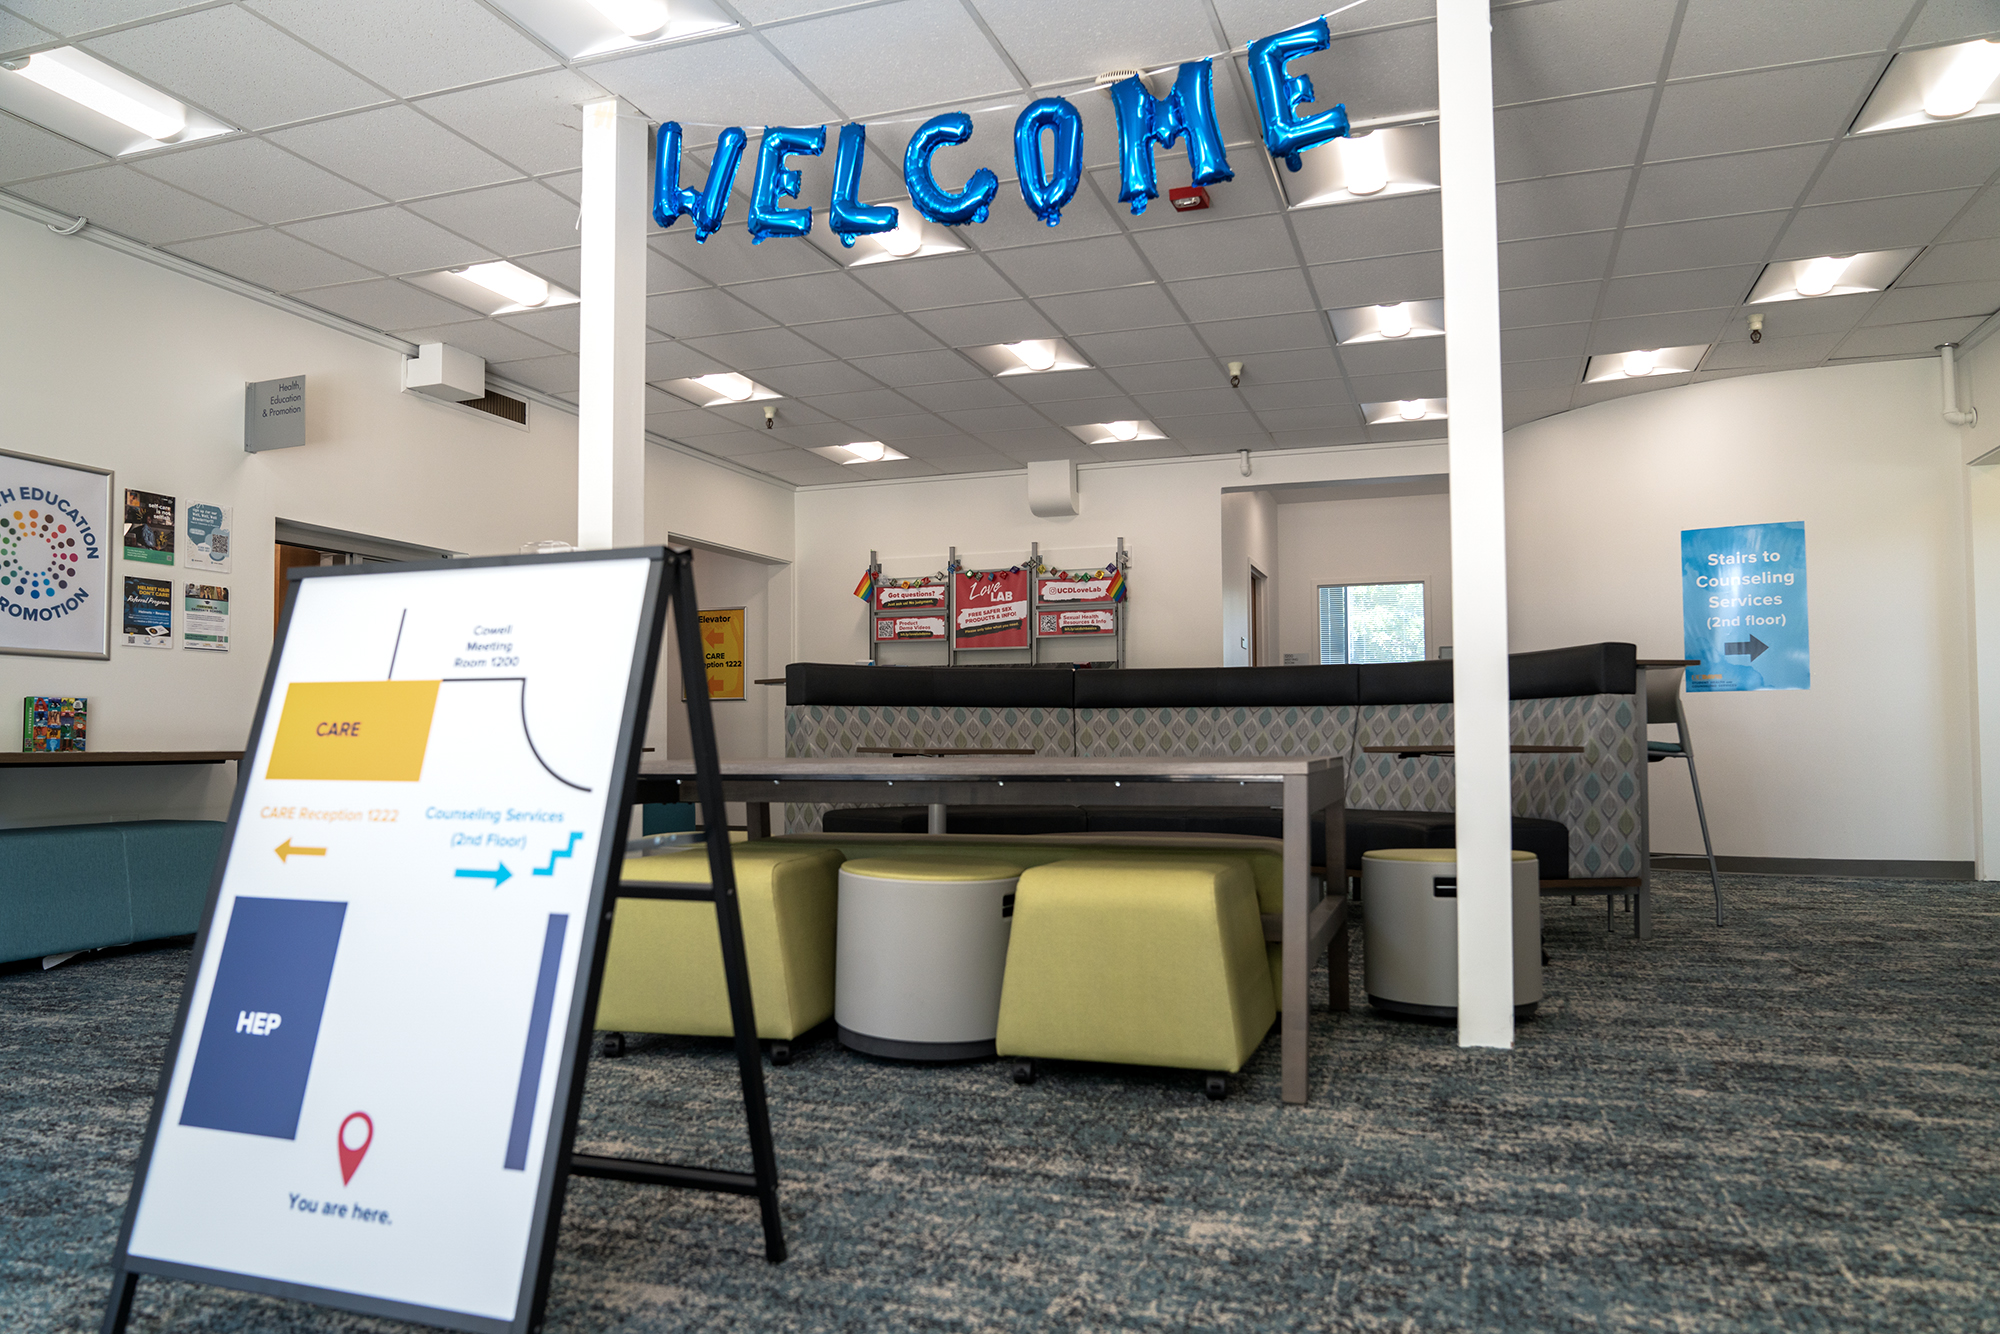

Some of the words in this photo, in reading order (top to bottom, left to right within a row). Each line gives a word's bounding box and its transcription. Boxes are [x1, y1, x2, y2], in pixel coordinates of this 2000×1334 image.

[653, 16, 1350, 243] WELCOME
[278, 380, 302, 392] Health,
[270, 393, 302, 405] Education
[262, 408, 268, 418] &
[269, 405, 302, 417] Promotion
[19, 486, 100, 560] EDUCATION
[1707, 551, 1758, 566] Stairs
[1762, 550, 1781, 563] to
[1696, 571, 1795, 588] Counseling
[900, 590, 936, 599] questions?
[968, 581, 1003, 601] Love
[990, 591, 1013, 602] LAB
[1057, 586, 1102, 594] UCDLoveLab
[0, 587, 90, 622] ROMOTION
[148, 597, 170, 607] Program
[1708, 594, 1783, 609] Services
[964, 614, 996, 624] PRODUCTS
[968, 610, 982, 618] FREE
[982, 608, 1001, 616] SAFER
[1706, 615, 1741, 630] (2nd
[1744, 613, 1787, 627] floor)
[473, 625, 513, 636] Cowell
[466, 641, 513, 652] Meeting
[453, 657, 487, 668] Room
[491, 656, 520, 667] 1200
[705, 660, 724, 669] ption
[725, 660, 742, 668] 1222
[316, 721, 362, 738] CARE
[260, 806, 297, 820] CARE
[298, 806, 363, 823] Reception
[367, 808, 400, 823] 1222
[425, 805, 502, 824] Counseling
[505, 807, 565, 824] Services
[450, 832, 483, 848] (2nd
[486, 833, 527, 850] Floor)
[235, 1010, 282, 1036] HEP
[288, 1192, 319, 1213] You
[321, 1201, 348, 1218] are
[351, 1202, 393, 1225] here.
